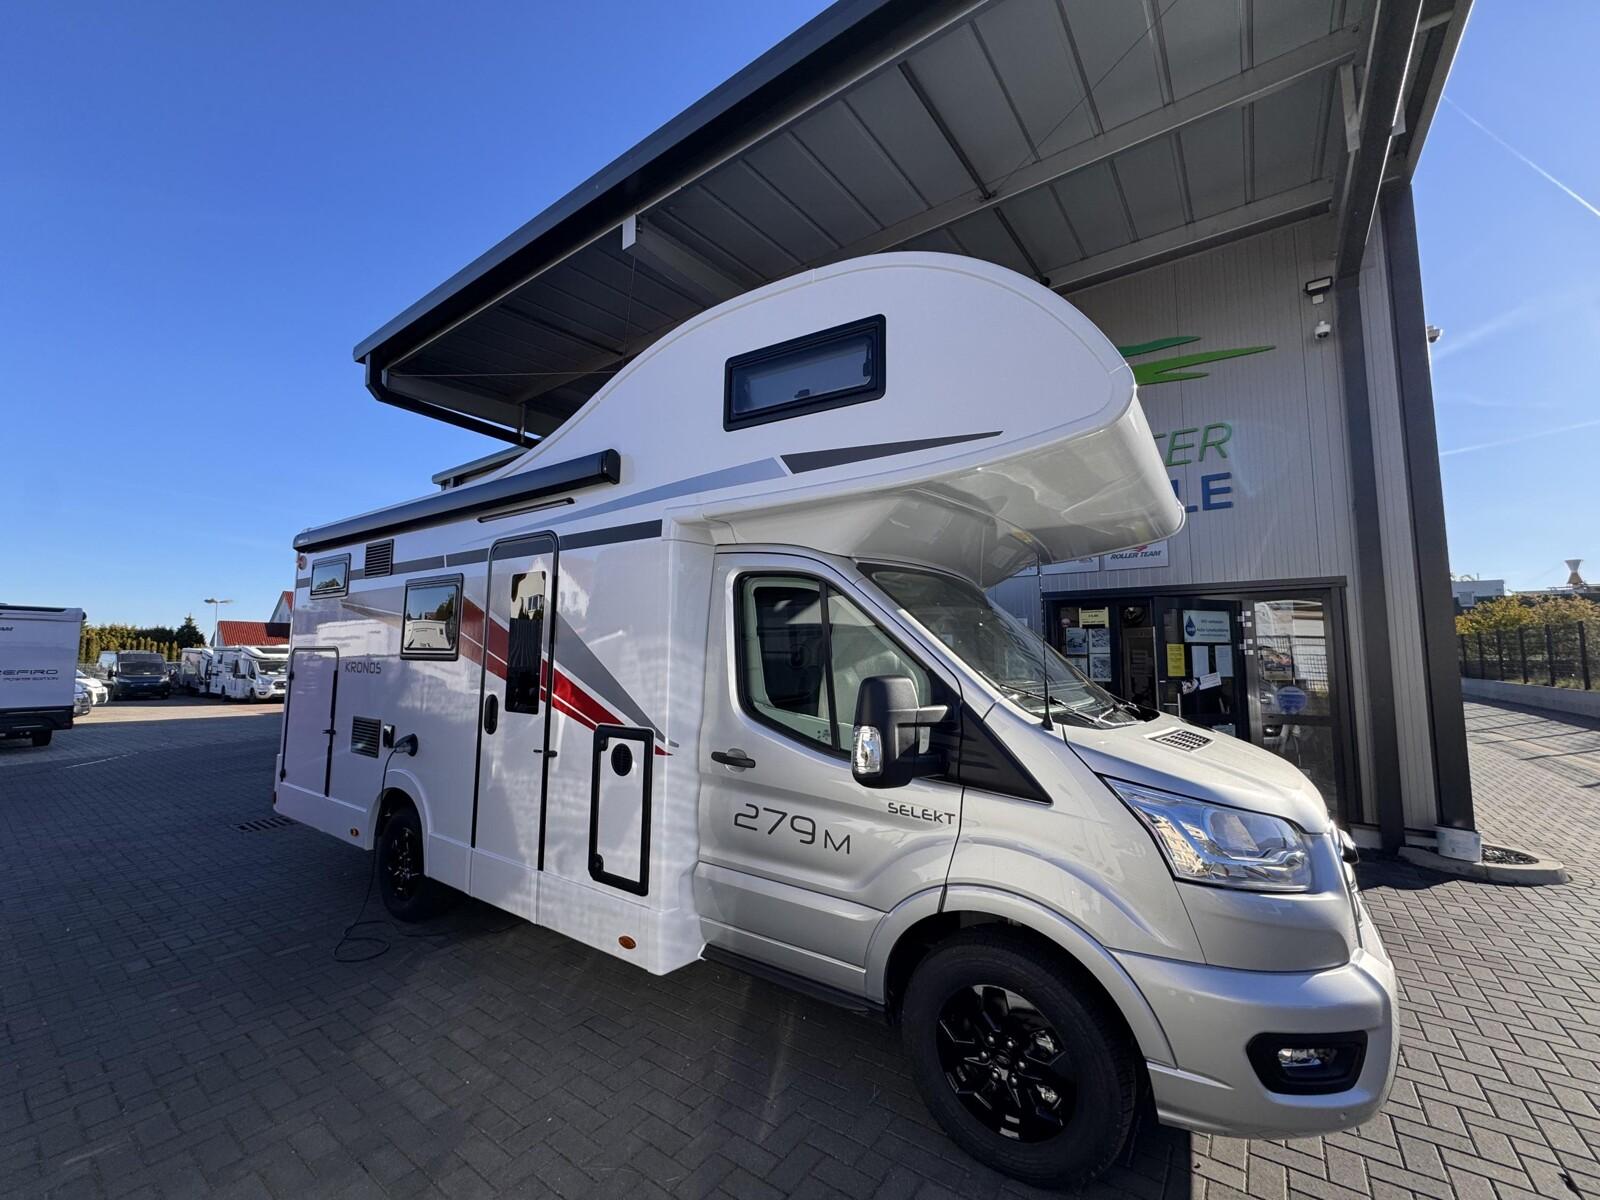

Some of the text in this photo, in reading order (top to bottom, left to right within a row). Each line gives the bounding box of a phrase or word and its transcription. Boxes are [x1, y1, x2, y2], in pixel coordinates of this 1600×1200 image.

[1154, 422, 1233, 467] ER
[1110, 550, 1161, 560] ROLLER TEAM
[345, 662, 382, 674] KRONOS
[887, 802, 956, 825] SELEKT
[733, 802, 851, 855] 279 M
